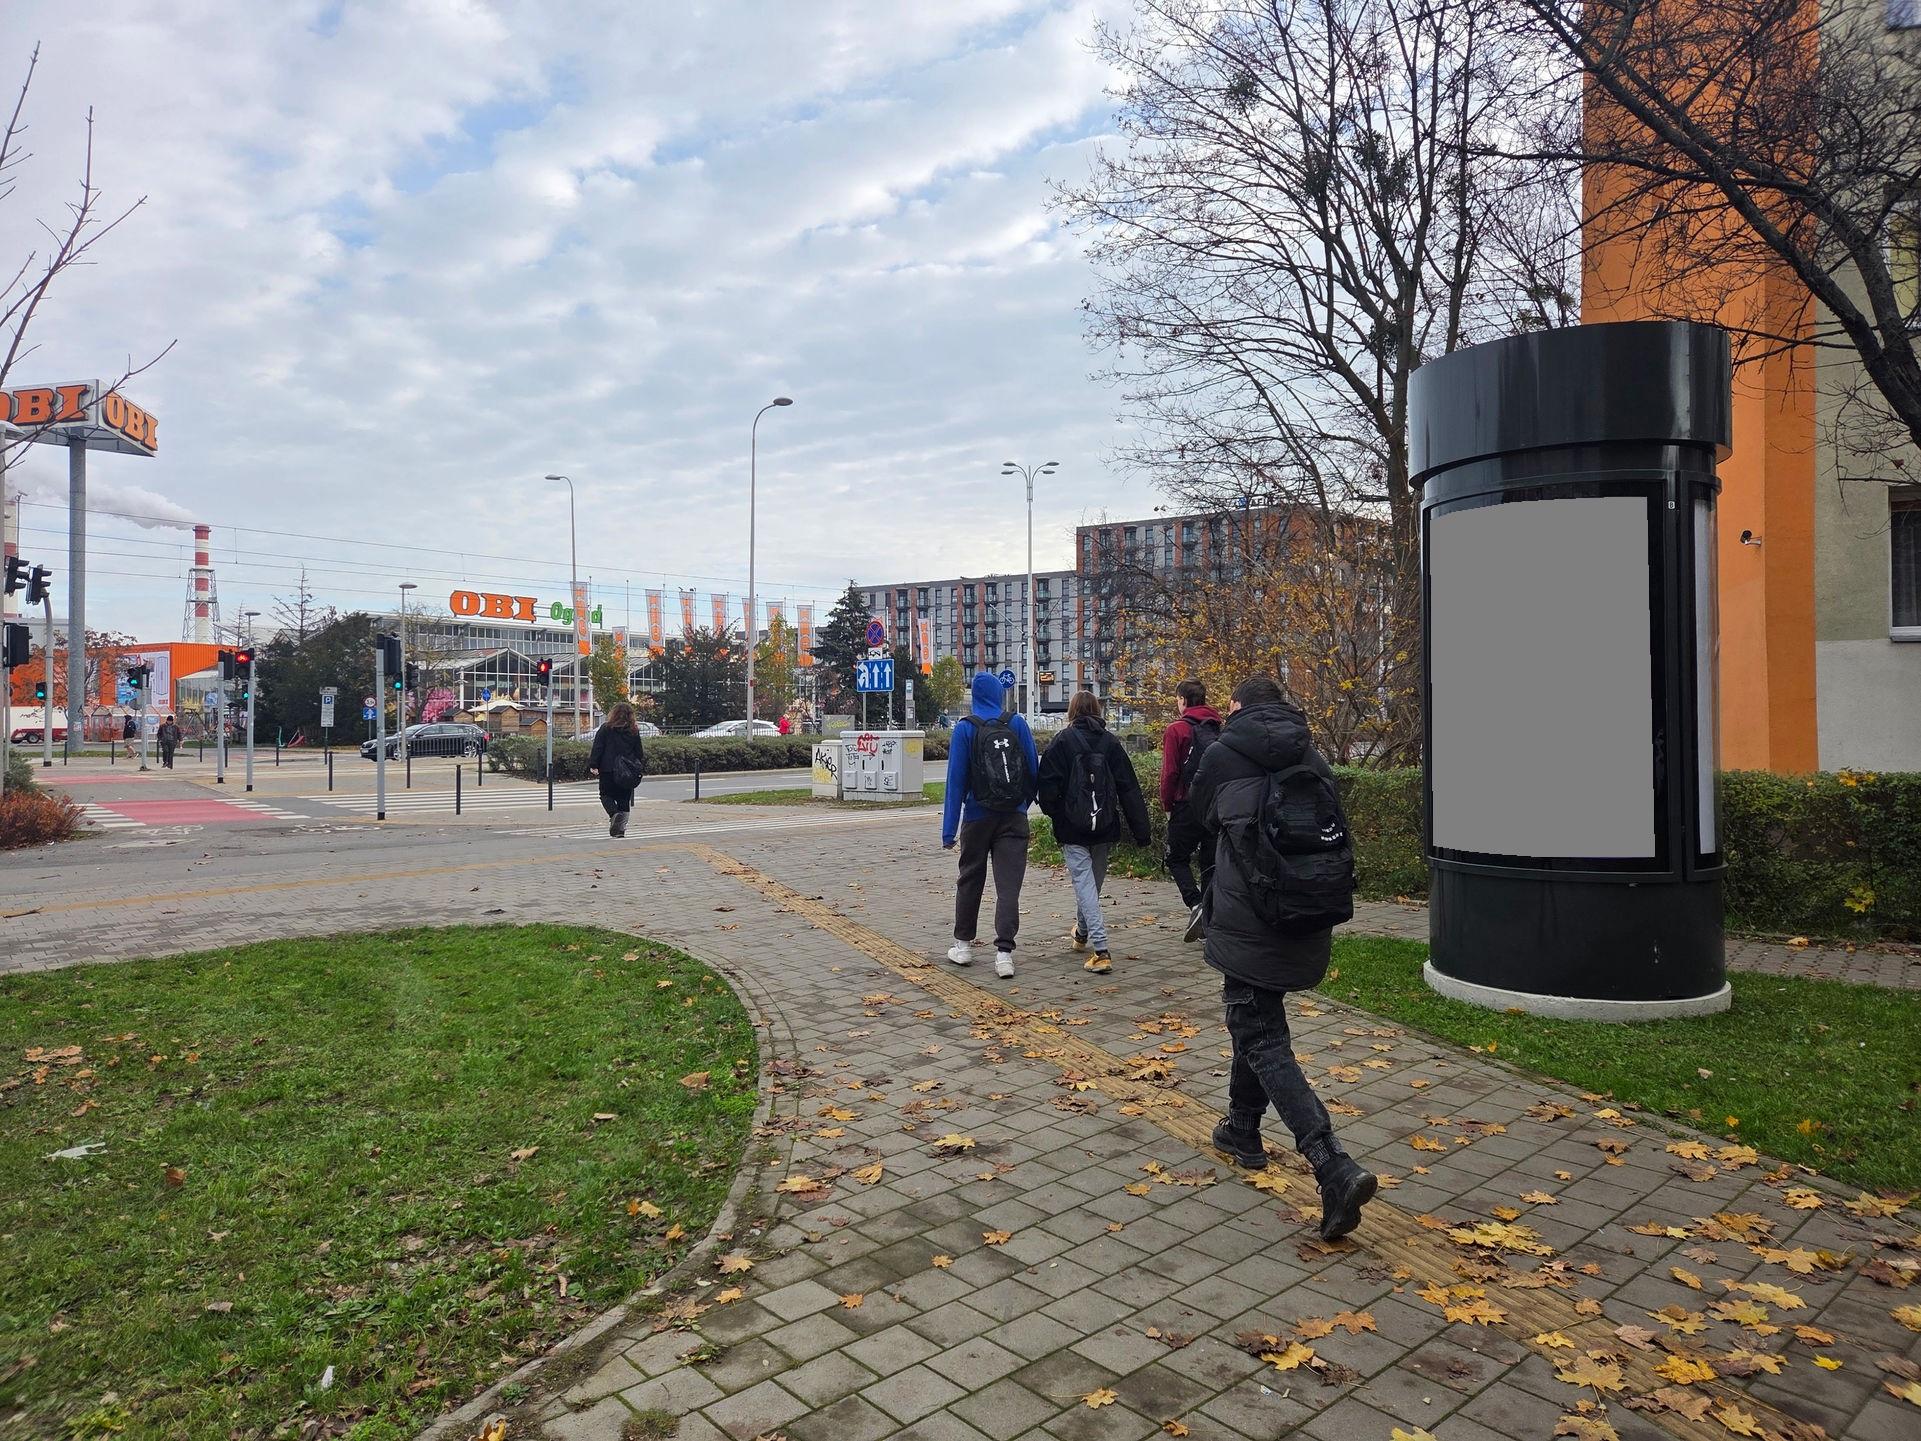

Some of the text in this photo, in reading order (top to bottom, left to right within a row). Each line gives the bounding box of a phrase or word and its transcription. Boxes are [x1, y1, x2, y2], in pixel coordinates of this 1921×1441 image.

[103, 391, 158, 451] OBI
[450, 590, 602, 625] OBI Ogd
